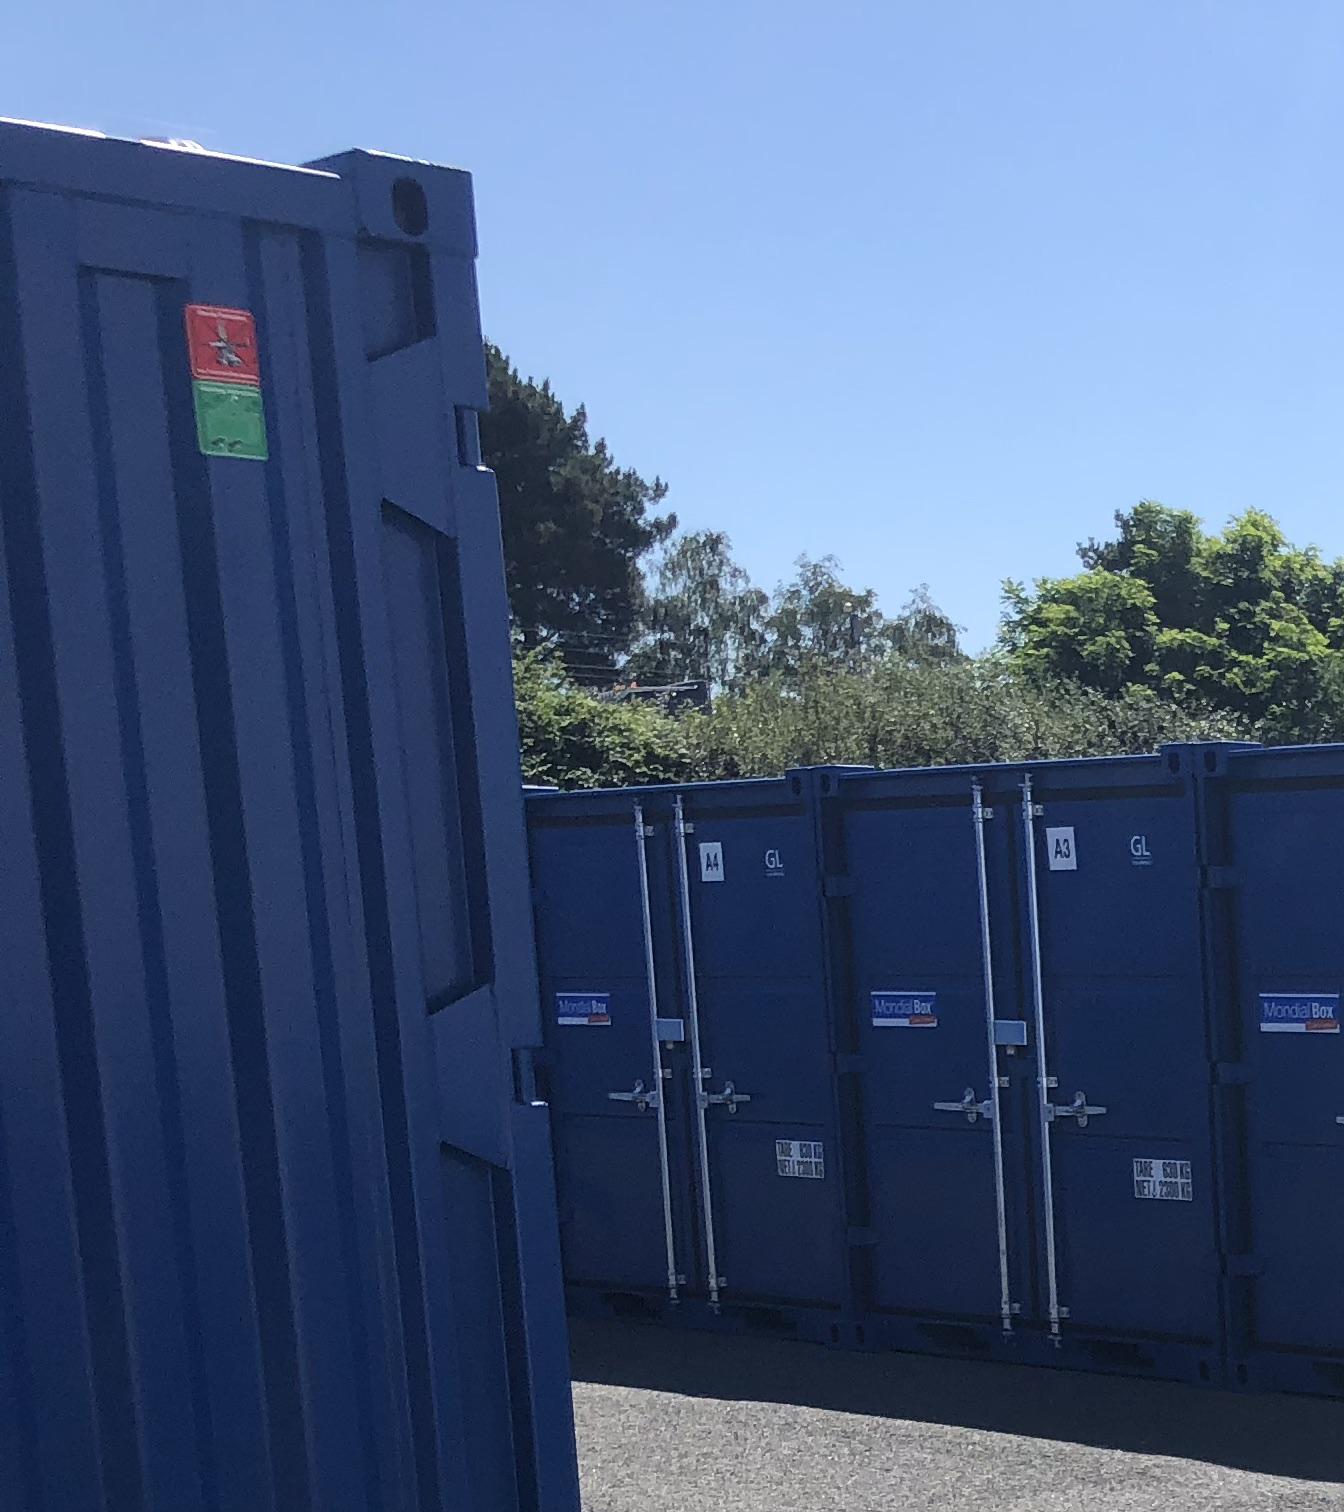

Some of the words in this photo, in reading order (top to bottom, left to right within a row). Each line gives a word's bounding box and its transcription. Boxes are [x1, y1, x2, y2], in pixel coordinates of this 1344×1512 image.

[1054, 838, 1071, 859] A3
[1130, 835, 1151, 856] GL
[705, 853, 719, 871] A4
[765, 850, 783, 868] GL
